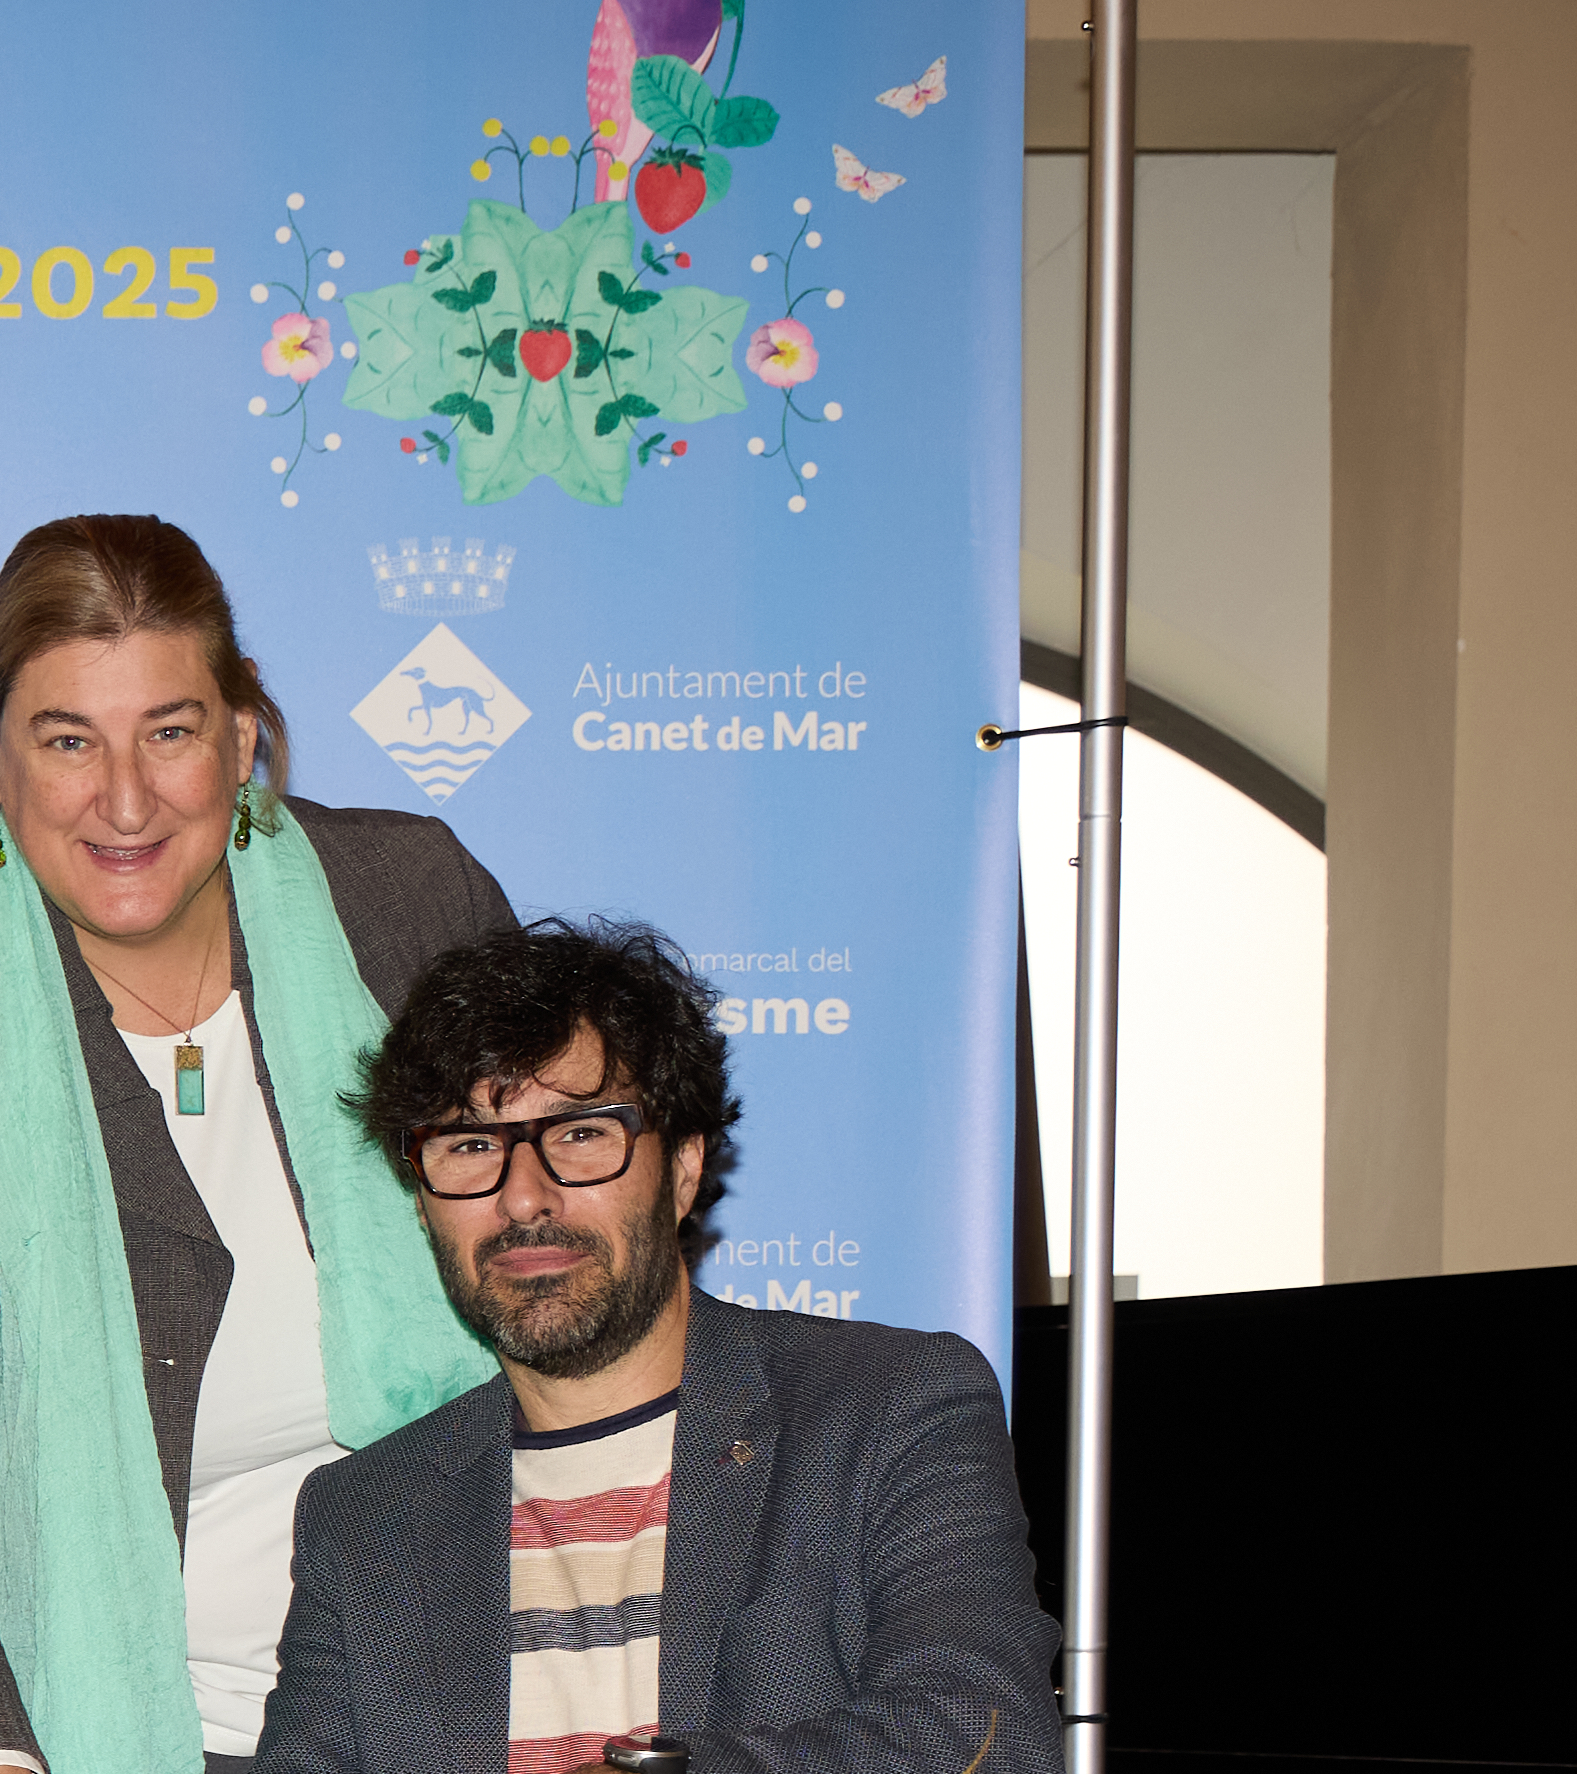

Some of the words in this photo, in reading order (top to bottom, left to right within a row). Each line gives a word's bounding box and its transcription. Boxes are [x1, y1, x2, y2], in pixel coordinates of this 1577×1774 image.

[572, 661, 808, 706] Ajuntament
[818, 661, 868, 699] de
[572, 710, 710, 752] Canet
[716, 715, 765, 752] de
[773, 710, 868, 752] Mar
[807, 946, 853, 972] del
[811, 1229, 860, 1267] de
[767, 1280, 860, 1320] Mar
